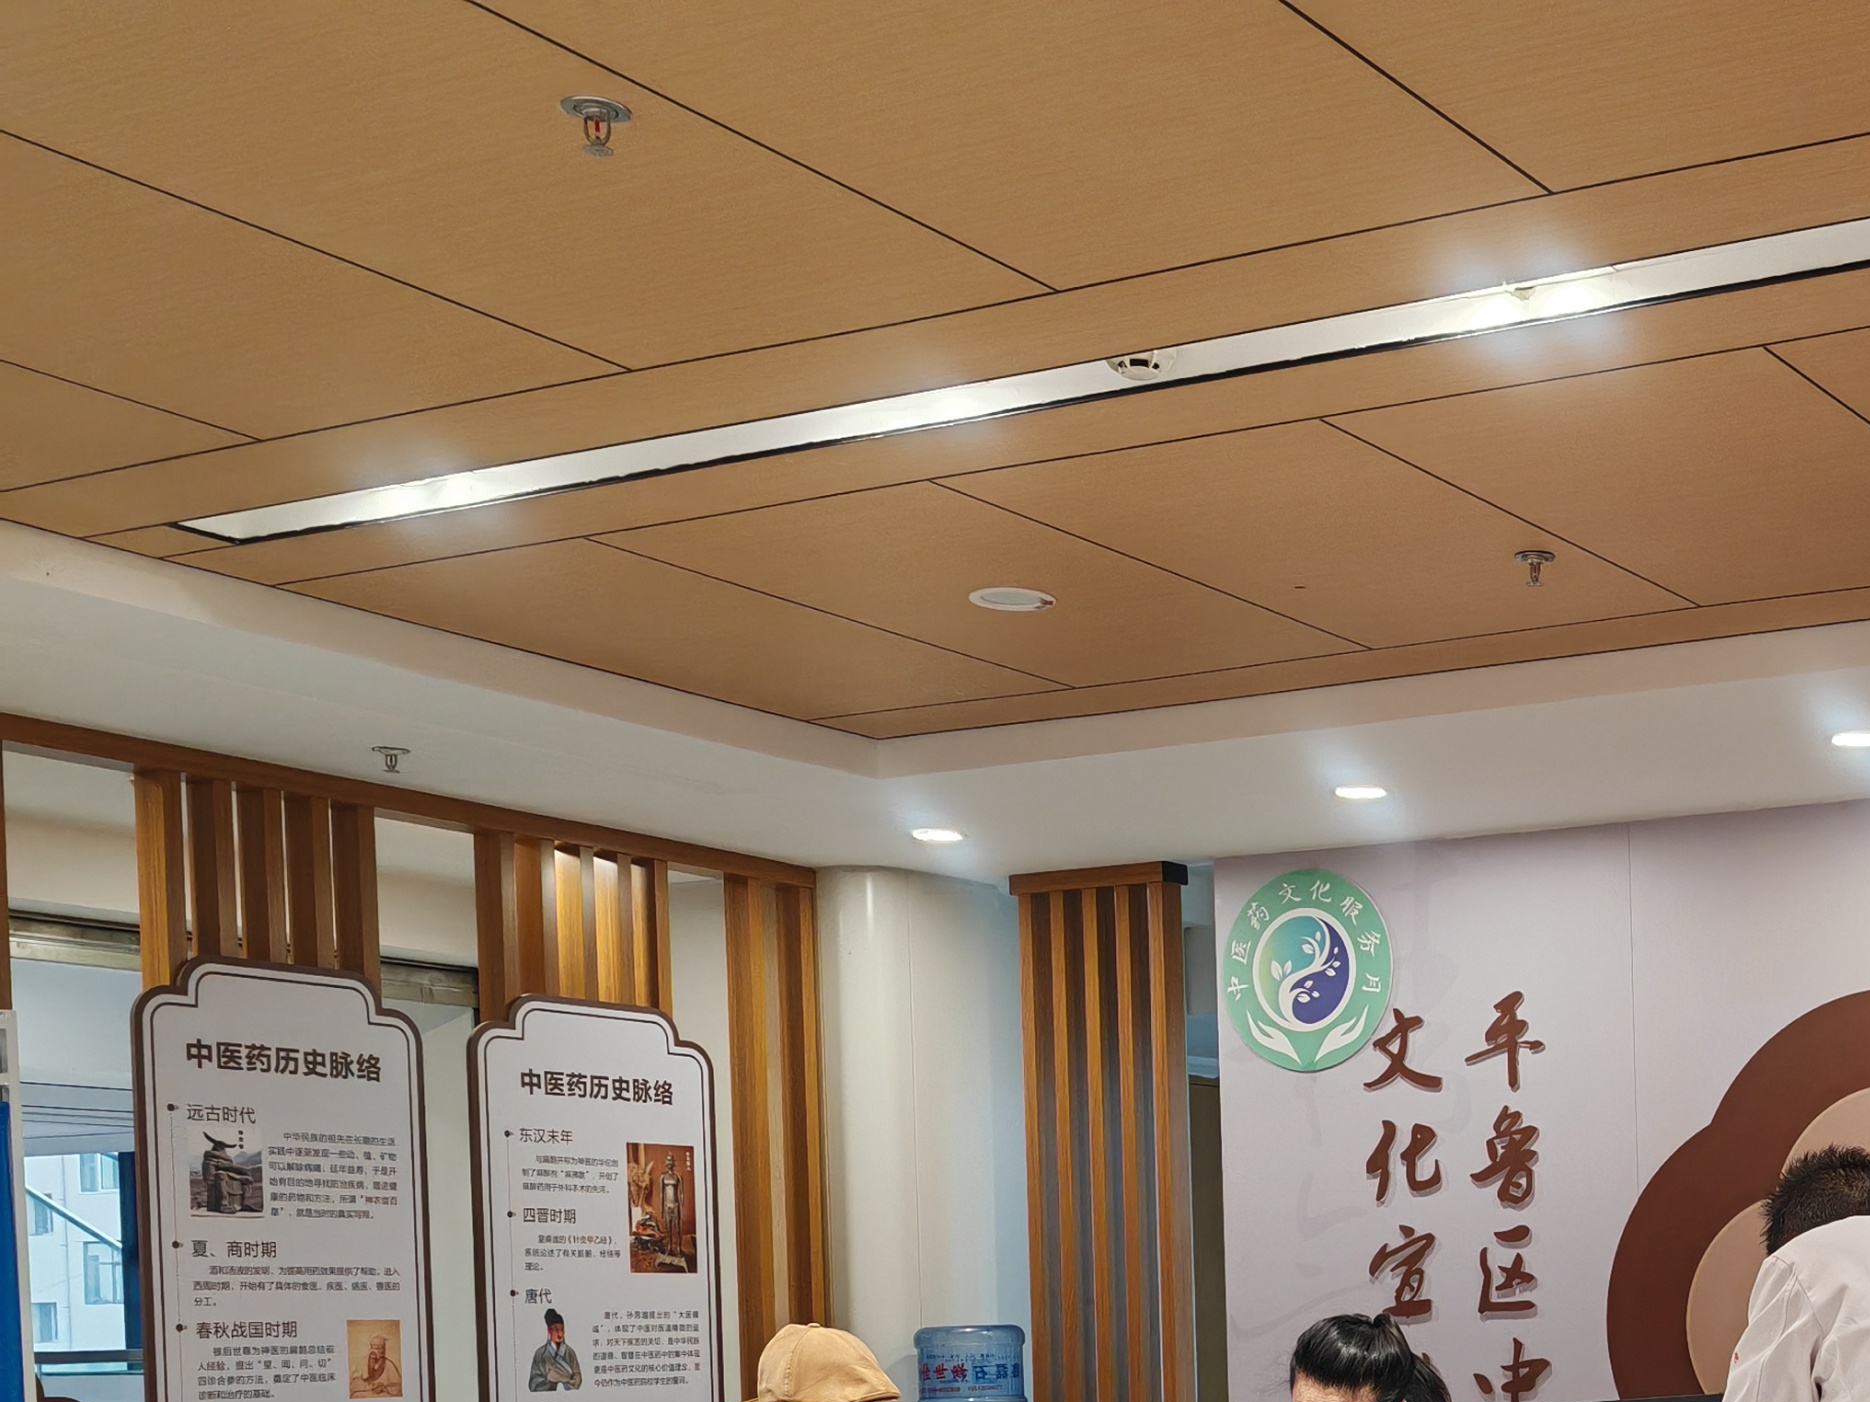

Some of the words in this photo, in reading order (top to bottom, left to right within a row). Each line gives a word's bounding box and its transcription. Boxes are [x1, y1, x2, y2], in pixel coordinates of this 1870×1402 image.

[186, 1038, 382, 1083] 中医药历史脉络
[520, 1068, 674, 1106] 中医药历史脉络
[186, 1103, 257, 1125] 远古时代
[519, 1127, 573, 1145] 东汉末年
[1363, 1008, 1443, 1362] 文化宣
[191, 1240, 277, 1258] 夏、商时期
[524, 1288, 553, 1305] 唐代
[196, 1321, 298, 1339] 春秋战国时期
